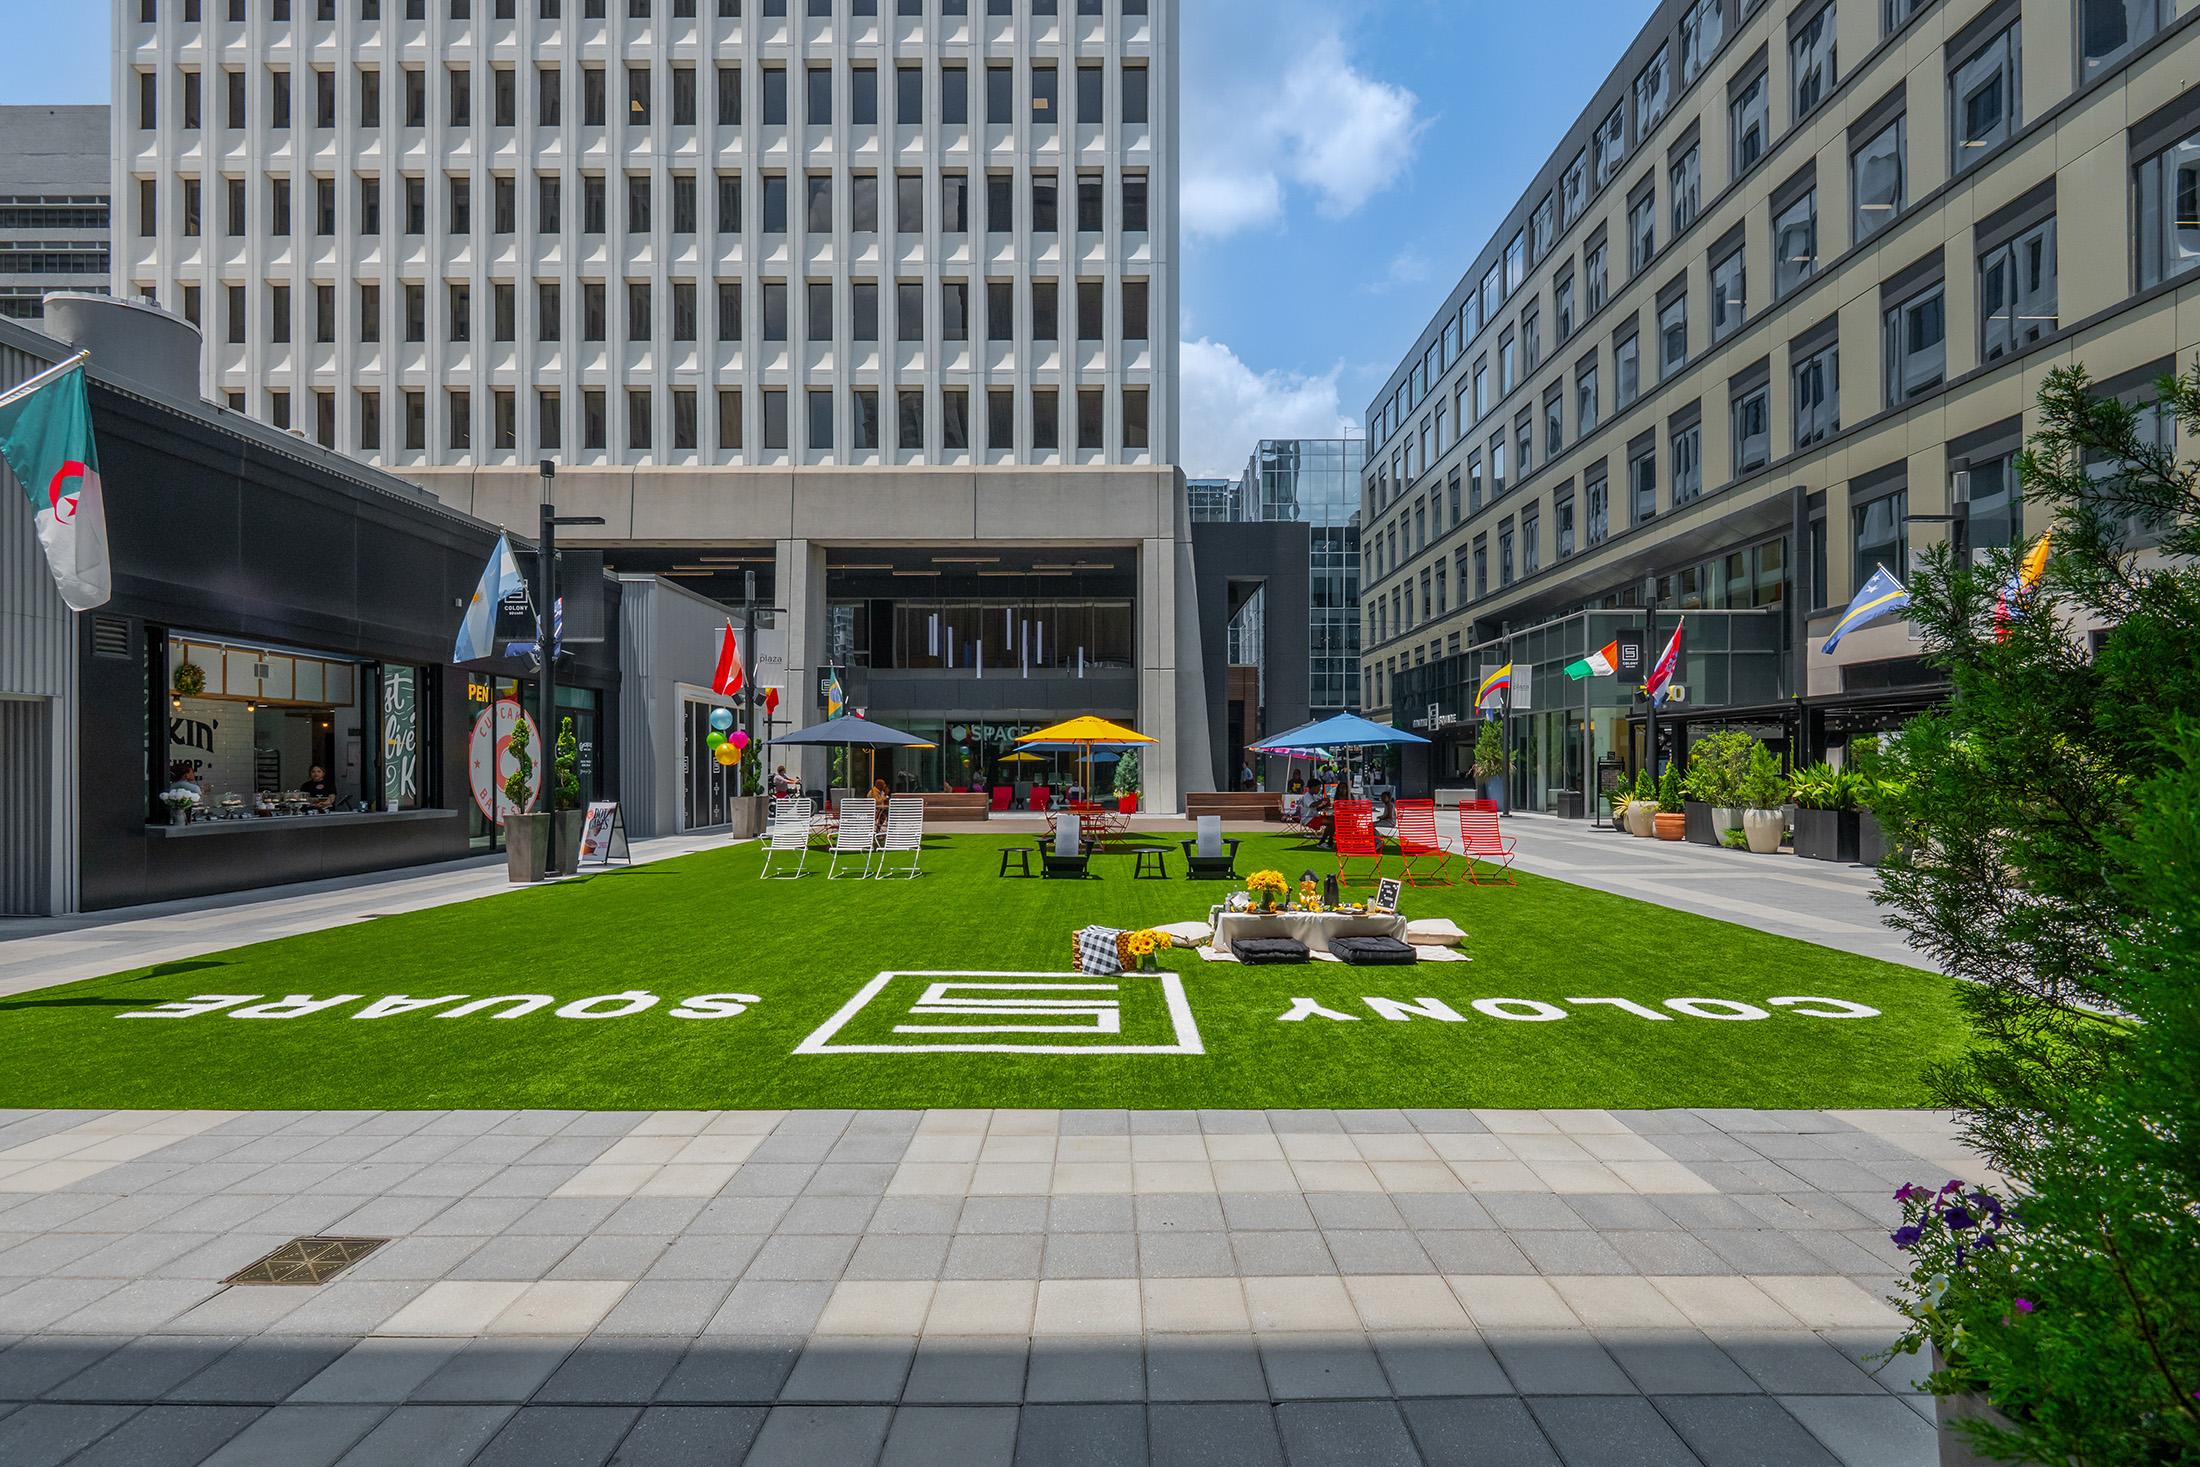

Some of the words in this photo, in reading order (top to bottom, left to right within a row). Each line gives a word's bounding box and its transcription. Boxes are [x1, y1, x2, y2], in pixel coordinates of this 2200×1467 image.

[759, 655, 782, 663] plaza
[468, 684, 489, 702] PEN
[479, 707, 535, 737] CUCAKN'
[114, 991, 761, 1019] SQUARE
[1277, 997, 1882, 1021] COLONY
